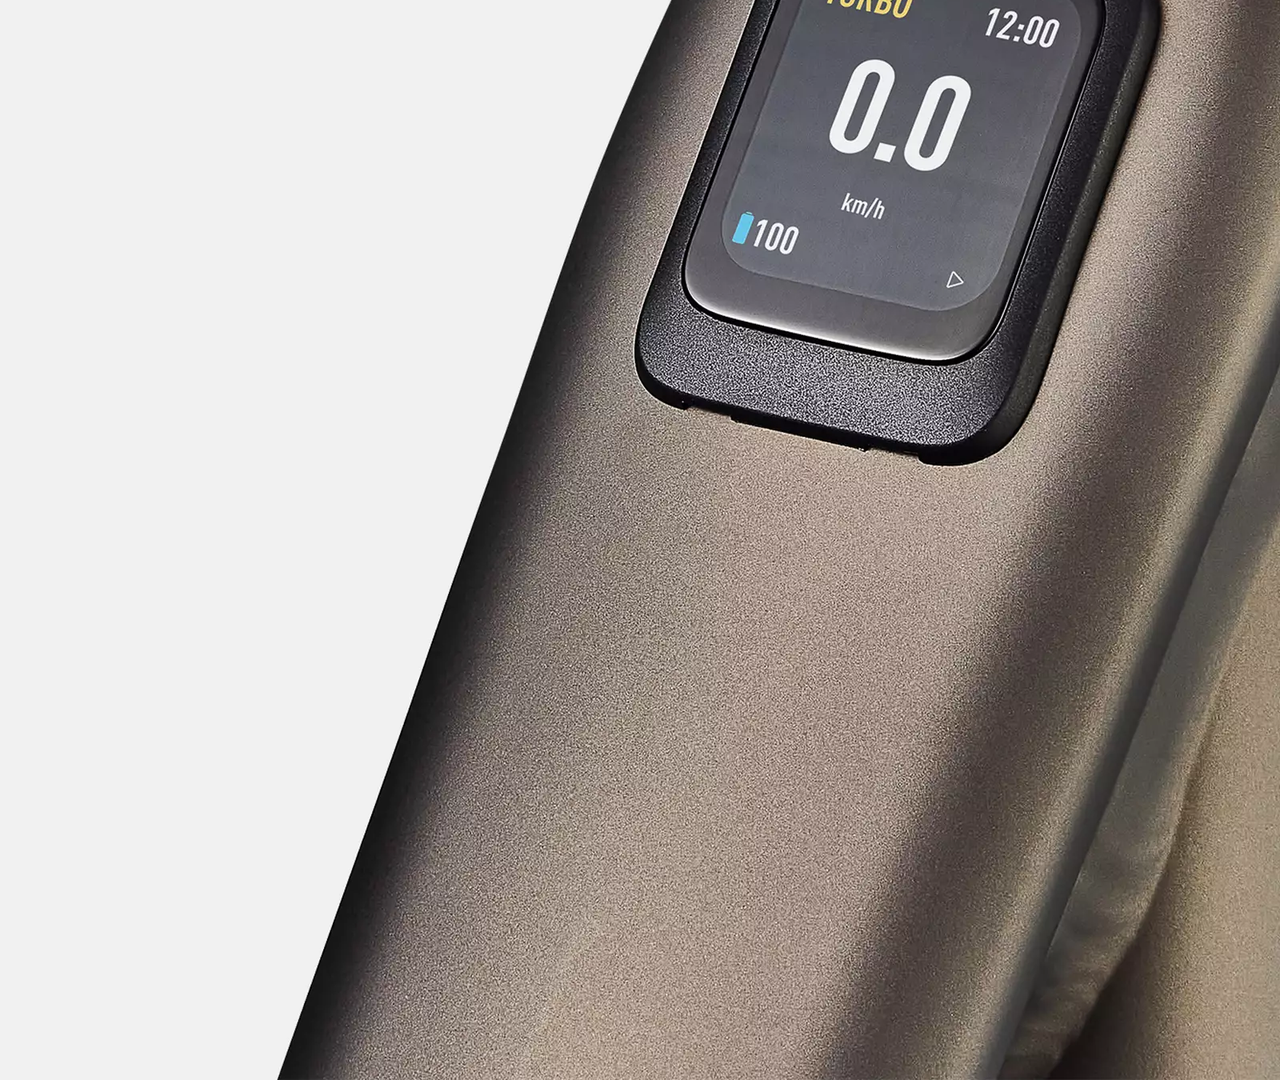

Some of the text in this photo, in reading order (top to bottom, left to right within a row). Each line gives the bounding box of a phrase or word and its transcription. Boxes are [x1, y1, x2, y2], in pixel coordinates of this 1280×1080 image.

[984, 7, 1060, 49] 12:00
[828, 58, 972, 172] 0.0
[840, 192, 886, 220] km/h
[753, 219, 800, 255] 100
